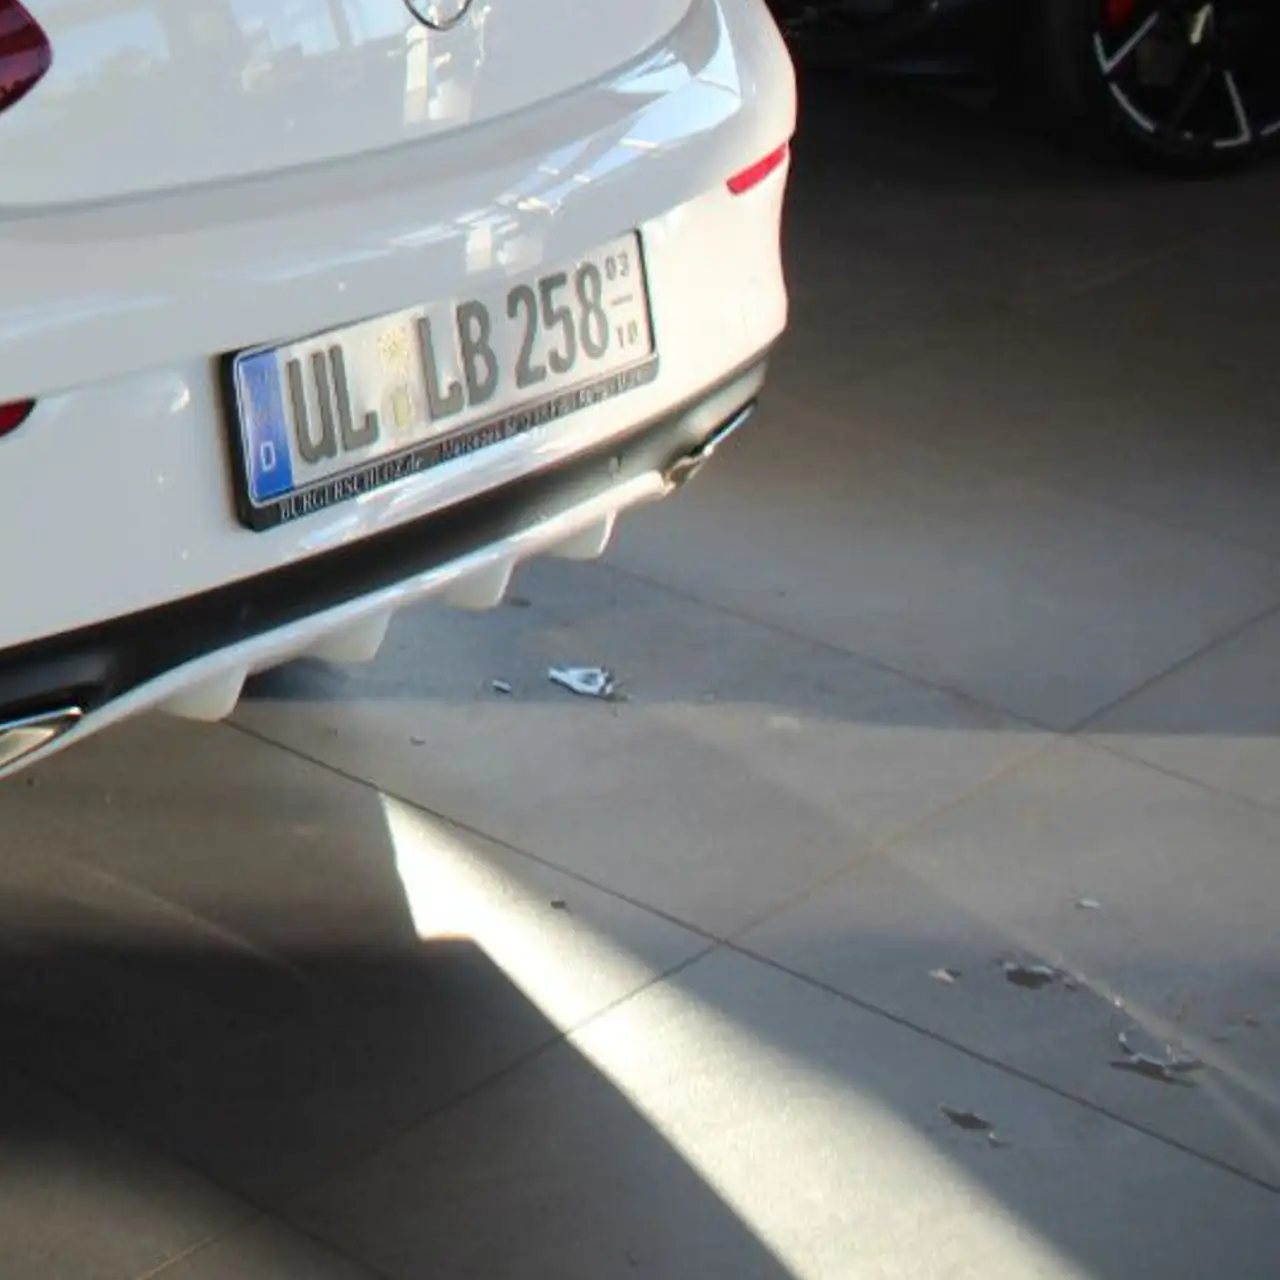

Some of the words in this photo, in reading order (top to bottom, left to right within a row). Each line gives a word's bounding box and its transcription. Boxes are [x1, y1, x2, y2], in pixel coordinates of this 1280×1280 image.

[604, 249, 630, 281] 03
[286, 343, 380, 464] UL
[415, 299, 500, 421] LB
[506, 261, 610, 390] 258
[259, 440, 277, 471] D
